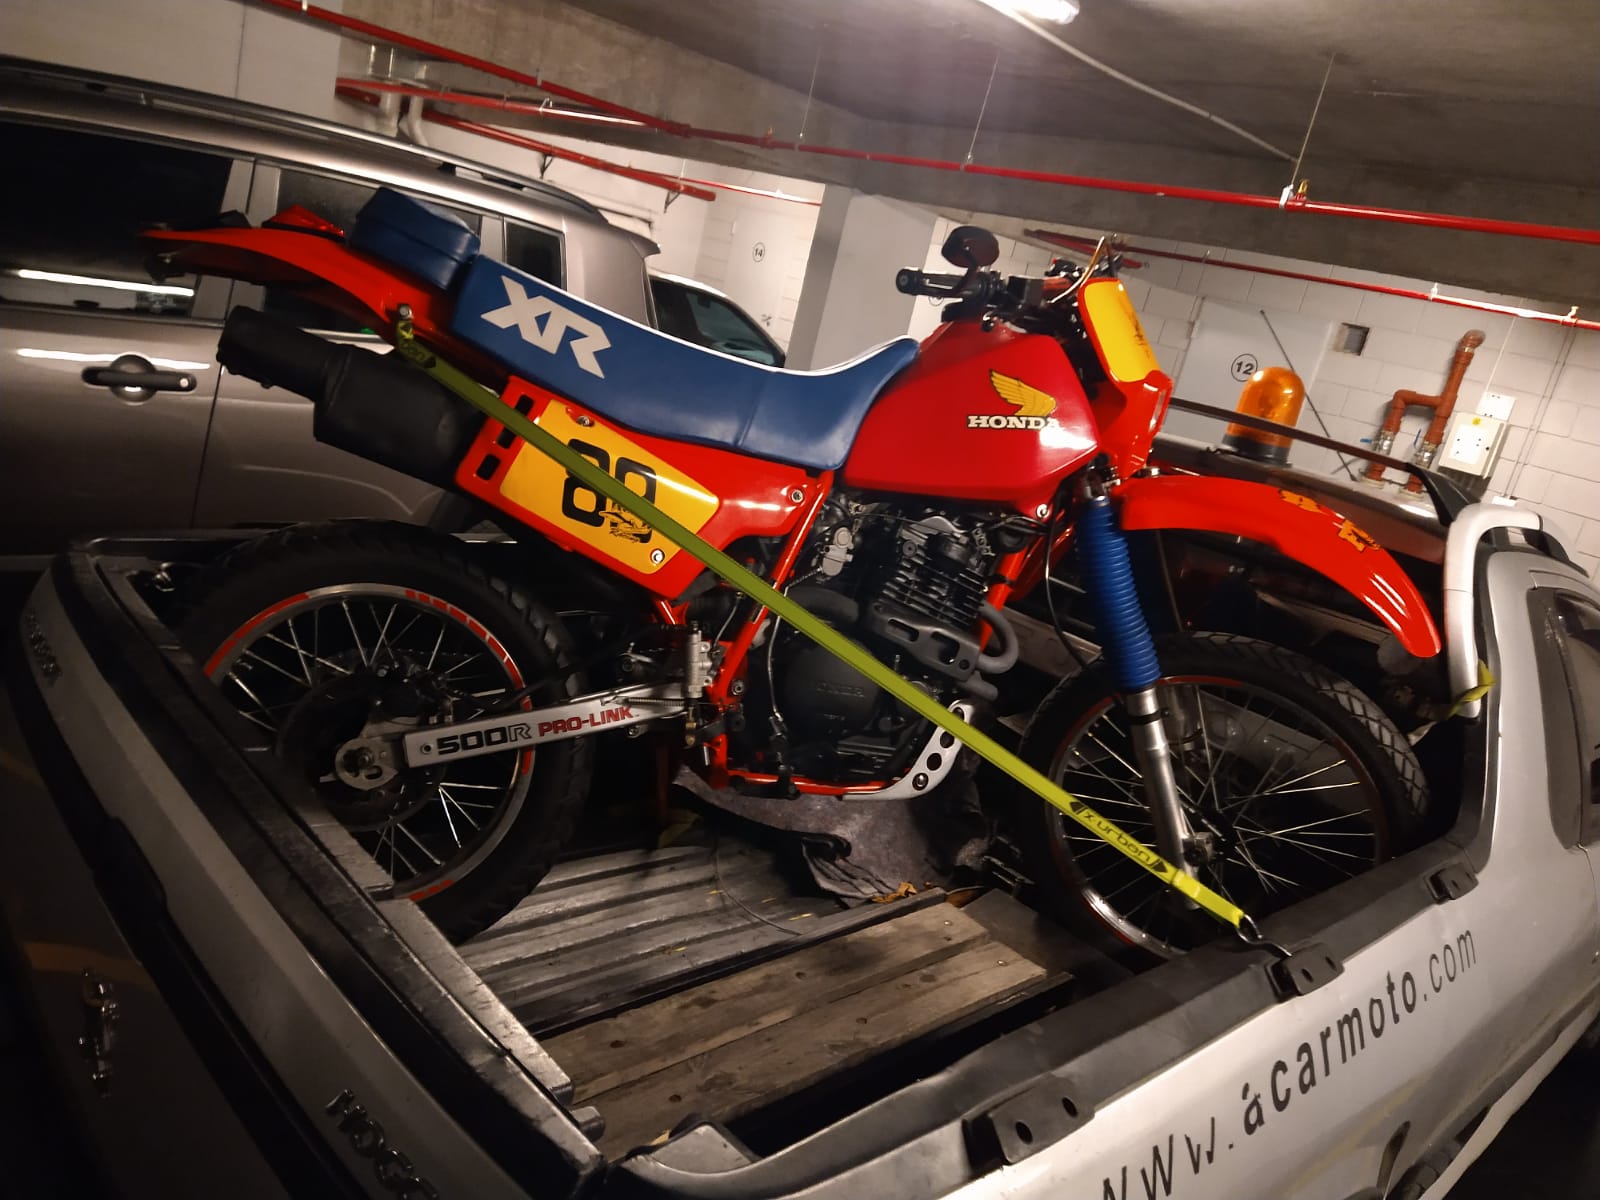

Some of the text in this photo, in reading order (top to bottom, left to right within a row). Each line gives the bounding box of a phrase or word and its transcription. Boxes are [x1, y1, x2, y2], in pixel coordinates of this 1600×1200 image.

[480, 274, 611, 379] XR
[1236, 361, 1254, 375] 12
[967, 415, 1060, 430] HONDA
[436, 705, 634, 756] 500R PRO-LINK
